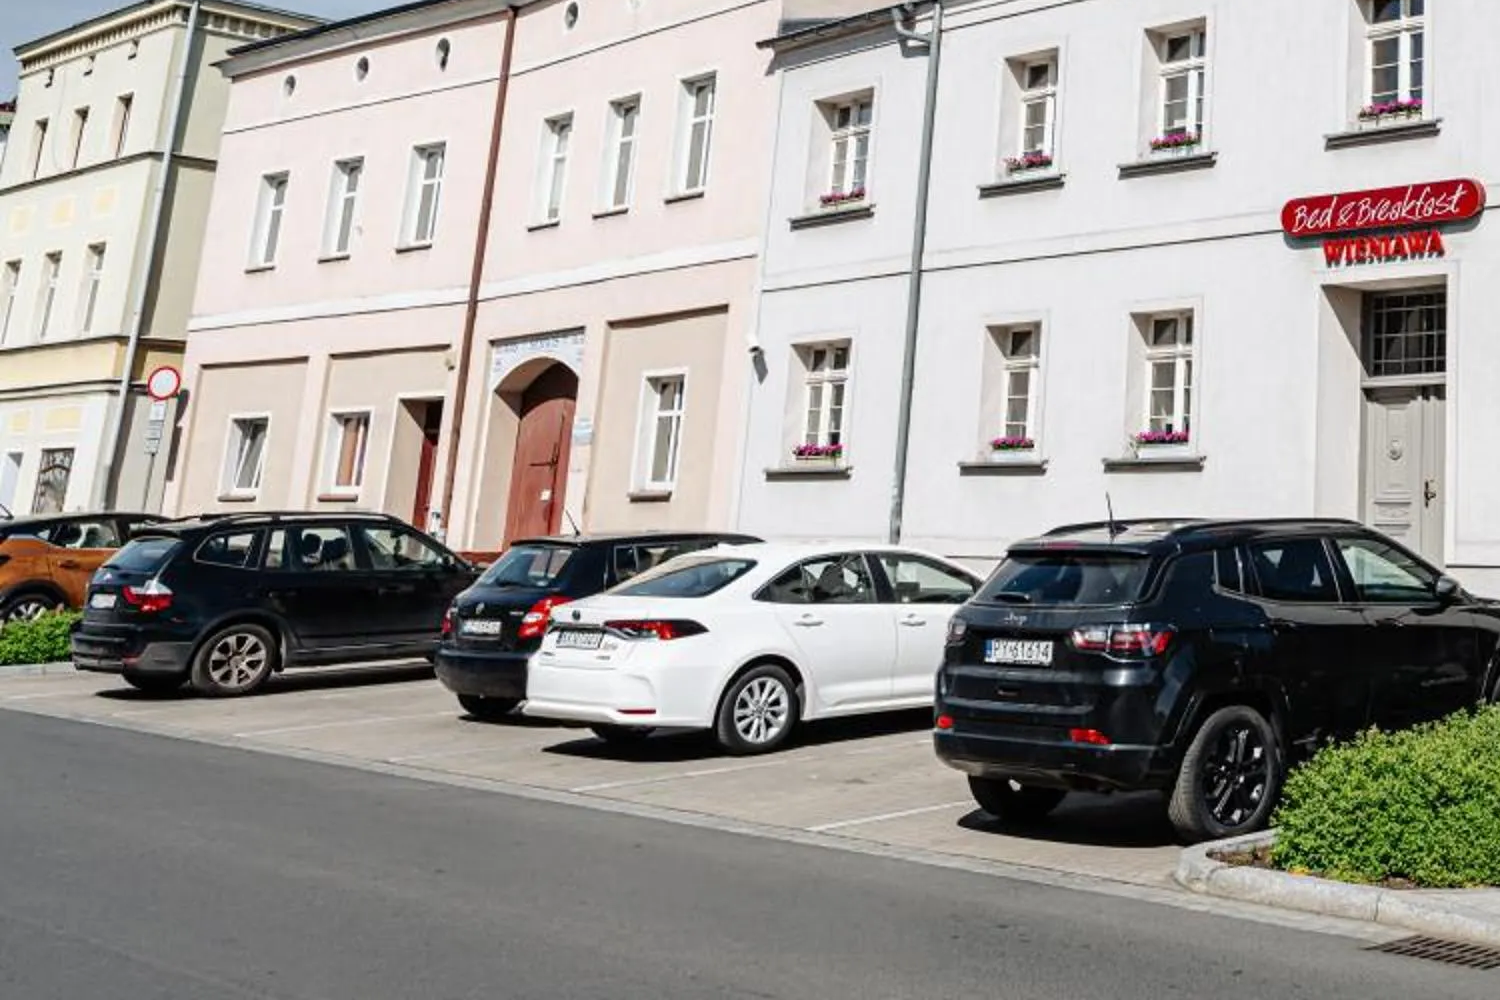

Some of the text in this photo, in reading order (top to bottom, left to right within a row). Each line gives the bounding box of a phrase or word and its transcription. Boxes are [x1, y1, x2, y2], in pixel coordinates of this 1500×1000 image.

[1292, 183, 1468, 232] Bed & Breakfast
[1323, 230, 1445, 267] WIENIAWA
